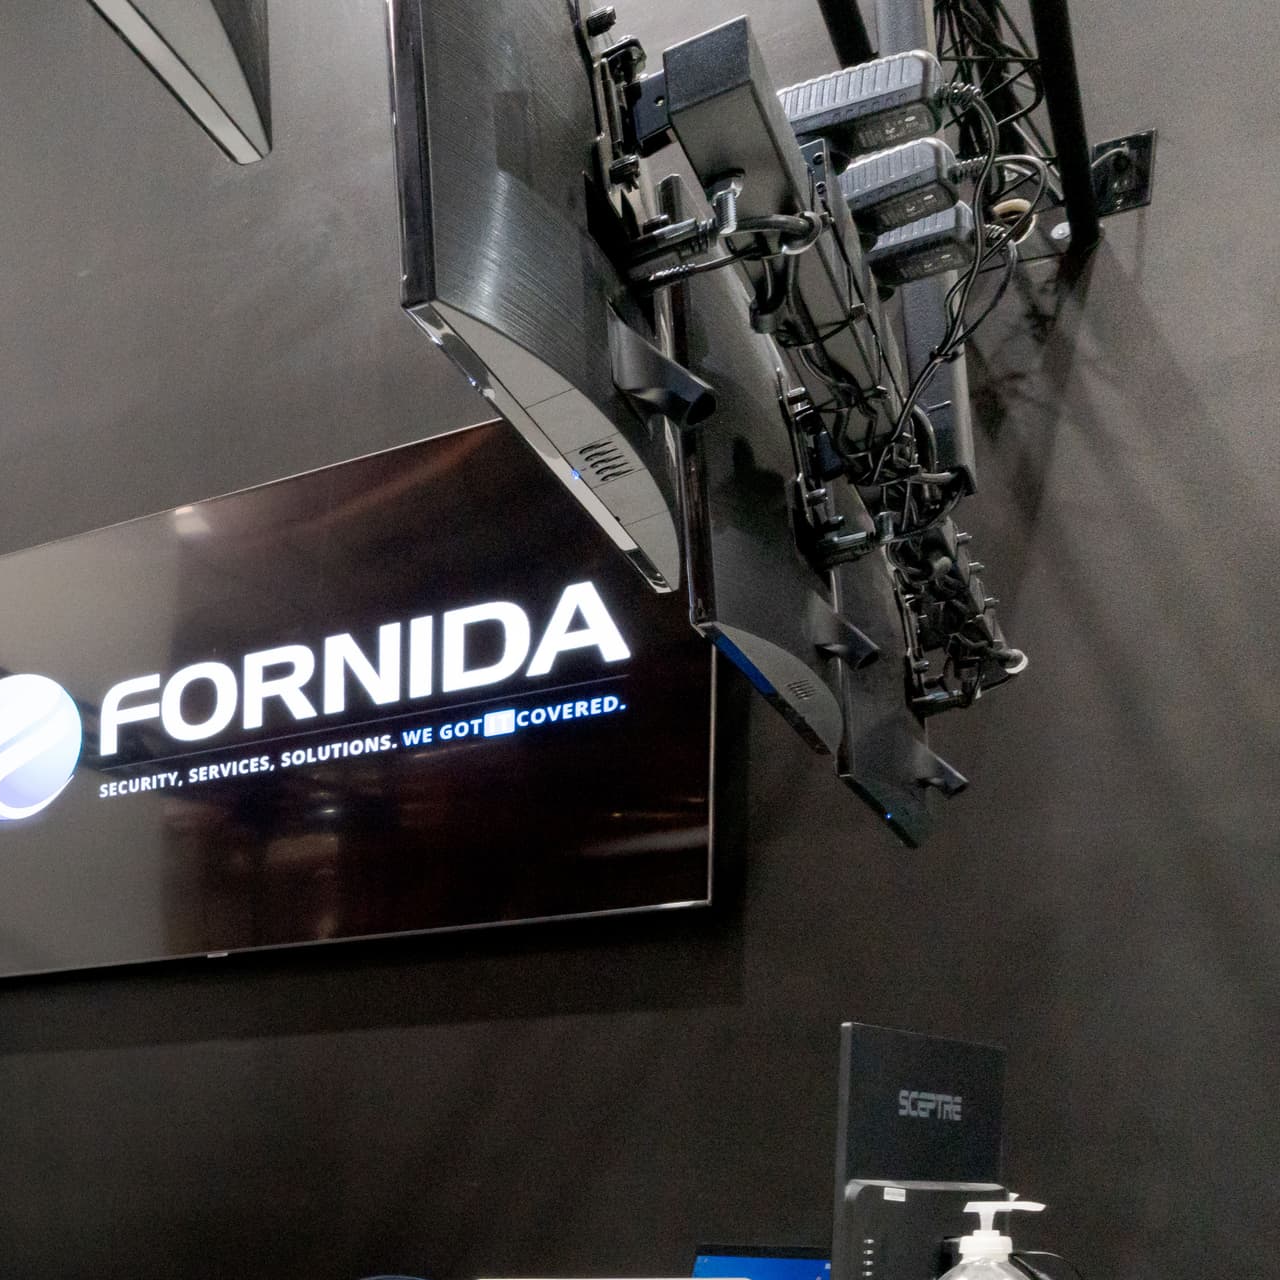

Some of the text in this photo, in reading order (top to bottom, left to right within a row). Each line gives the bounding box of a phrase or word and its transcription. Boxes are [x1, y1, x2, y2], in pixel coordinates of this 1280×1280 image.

[99, 581, 632, 756] FORNIDA
[99, 769, 185, 799] SECURITY,
[189, 753, 276, 786] SERVICES,
[281, 734, 398, 768] SOLUTIONS.
[403, 726, 433, 746] WE
[438, 719, 484, 743] GOT
[517, 696, 627, 727] COVERED.
[898, 1090, 963, 1121] SCEPTRE
